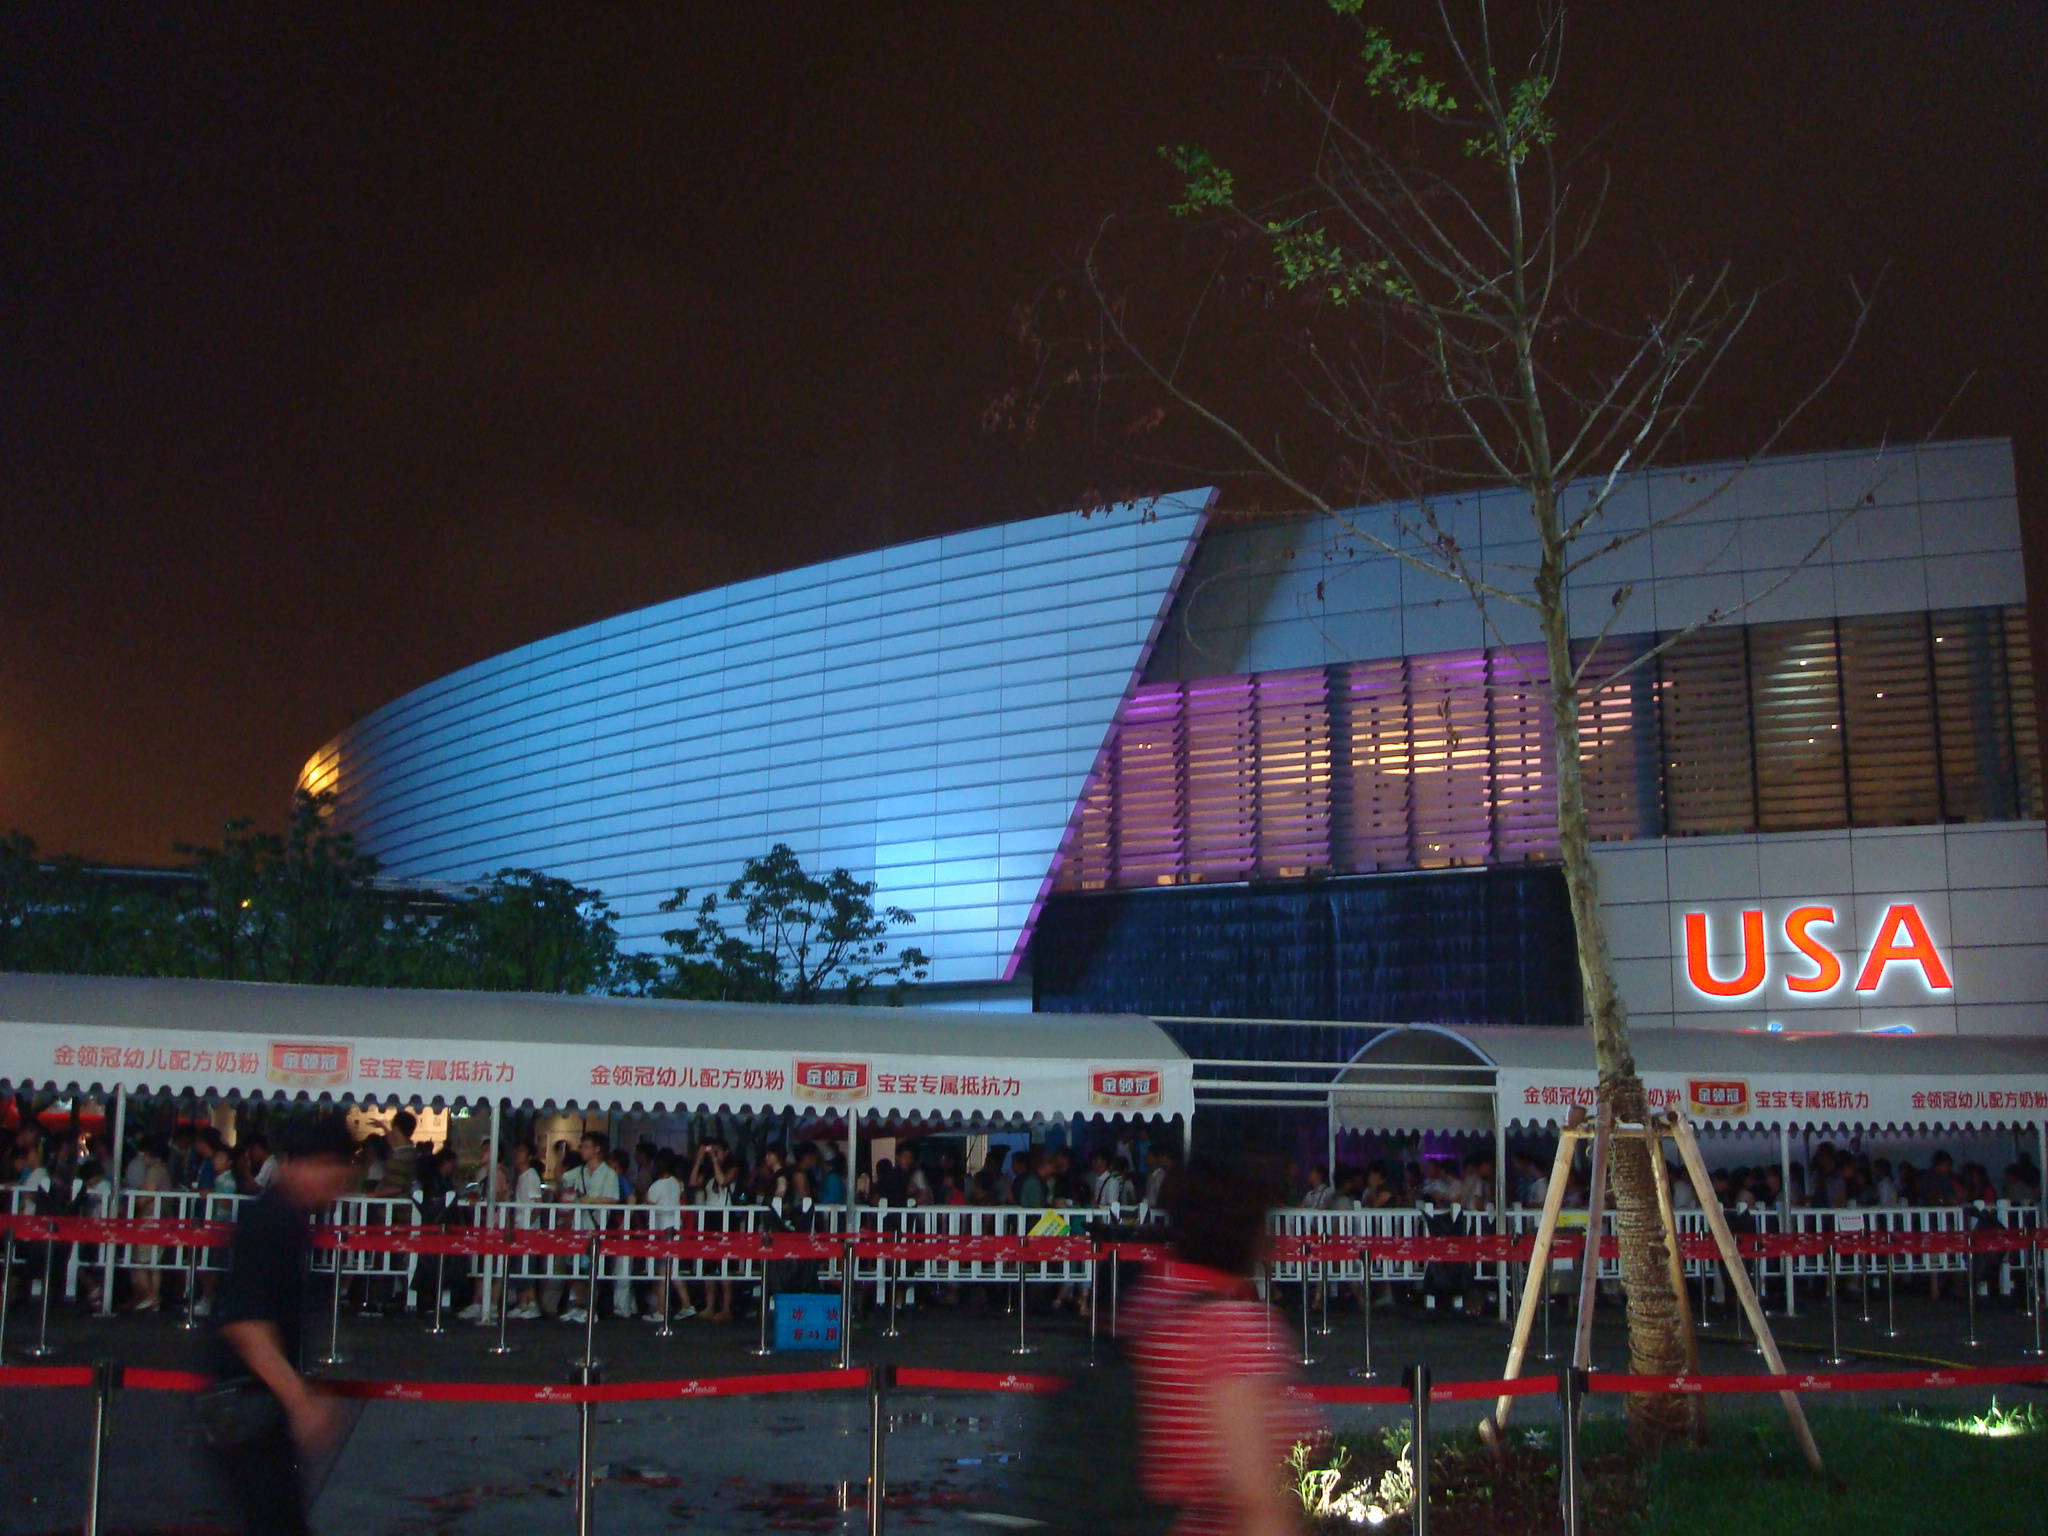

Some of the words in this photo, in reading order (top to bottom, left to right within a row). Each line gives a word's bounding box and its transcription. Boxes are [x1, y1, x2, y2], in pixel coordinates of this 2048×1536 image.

[1685, 904, 1953, 996] USA
[53, 1044, 260, 1074] 金领冠幼儿配方奶粉
[359, 1057, 515, 1083] 宝宝专属抵抗力
[590, 1065, 785, 1091] 金领冠幼儿配方奶粉
[806, 1069, 859, 1087] 金领冠
[877, 1073, 1021, 1096] 宝宝专属抵抗力
[1102, 1077, 1150, 1093] 金领冠
[1698, 1087, 1740, 1103] 金领冠
[1755, 1090, 1869, 1109] 宝宝专属抵抗力
[1911, 1091, 2048, 1109] 金领冠幼儿配方奶粉
